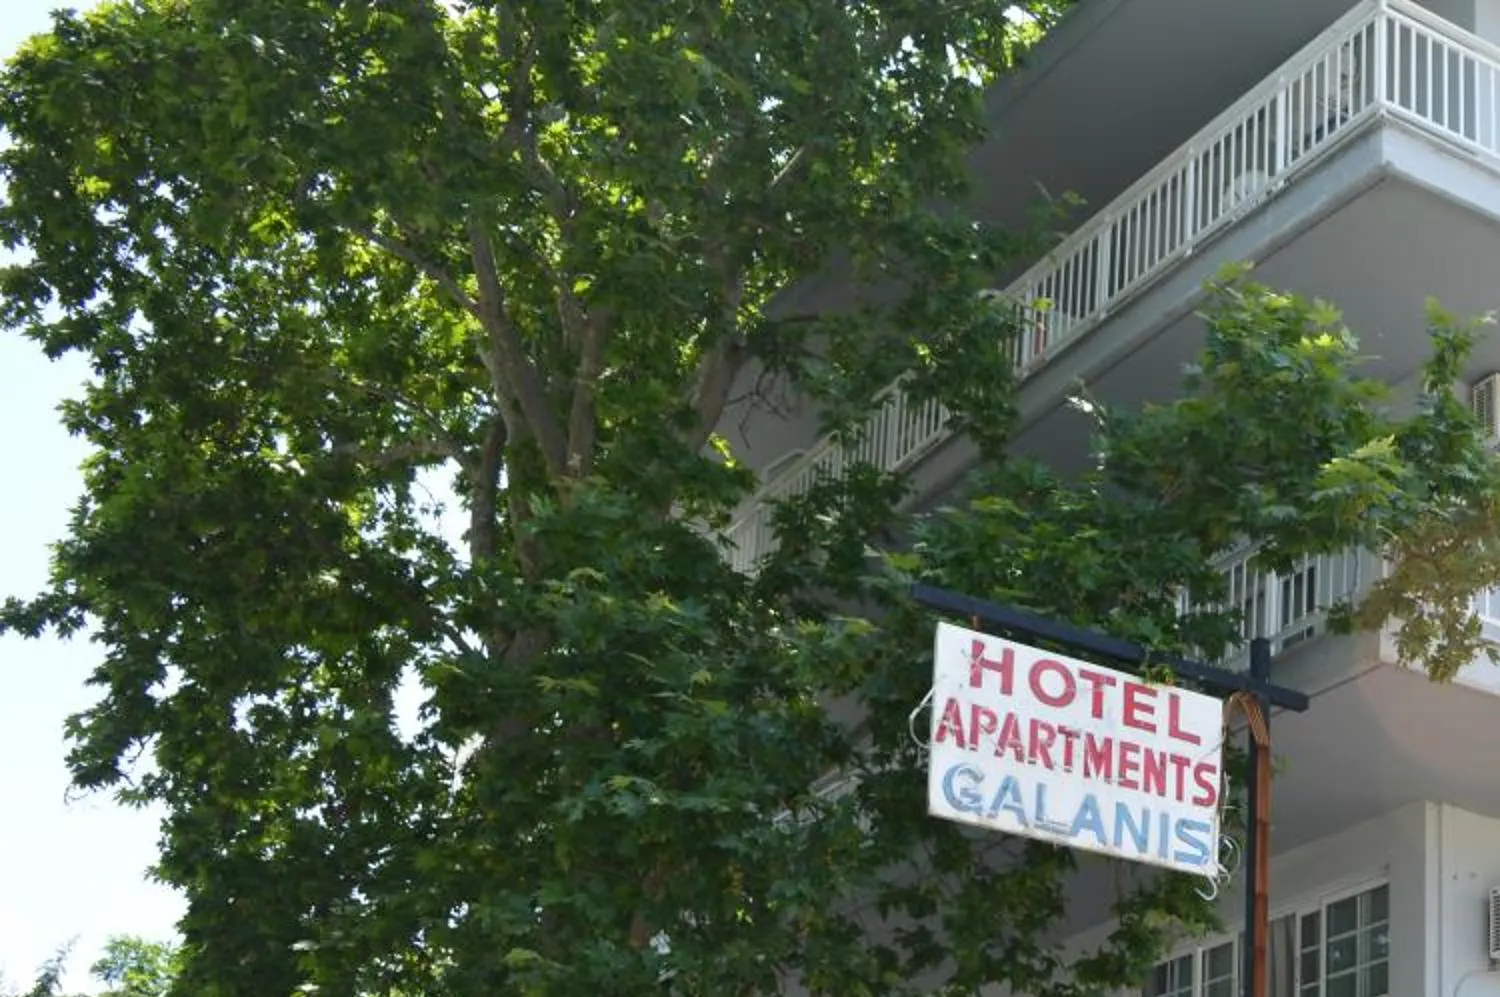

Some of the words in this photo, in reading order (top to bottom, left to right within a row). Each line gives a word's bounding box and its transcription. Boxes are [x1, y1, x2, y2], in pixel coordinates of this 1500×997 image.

[970, 639, 1201, 746] HOTEL
[935, 697, 1217, 807] APARTMENTS
[942, 762, 1211, 866] GALANIS
